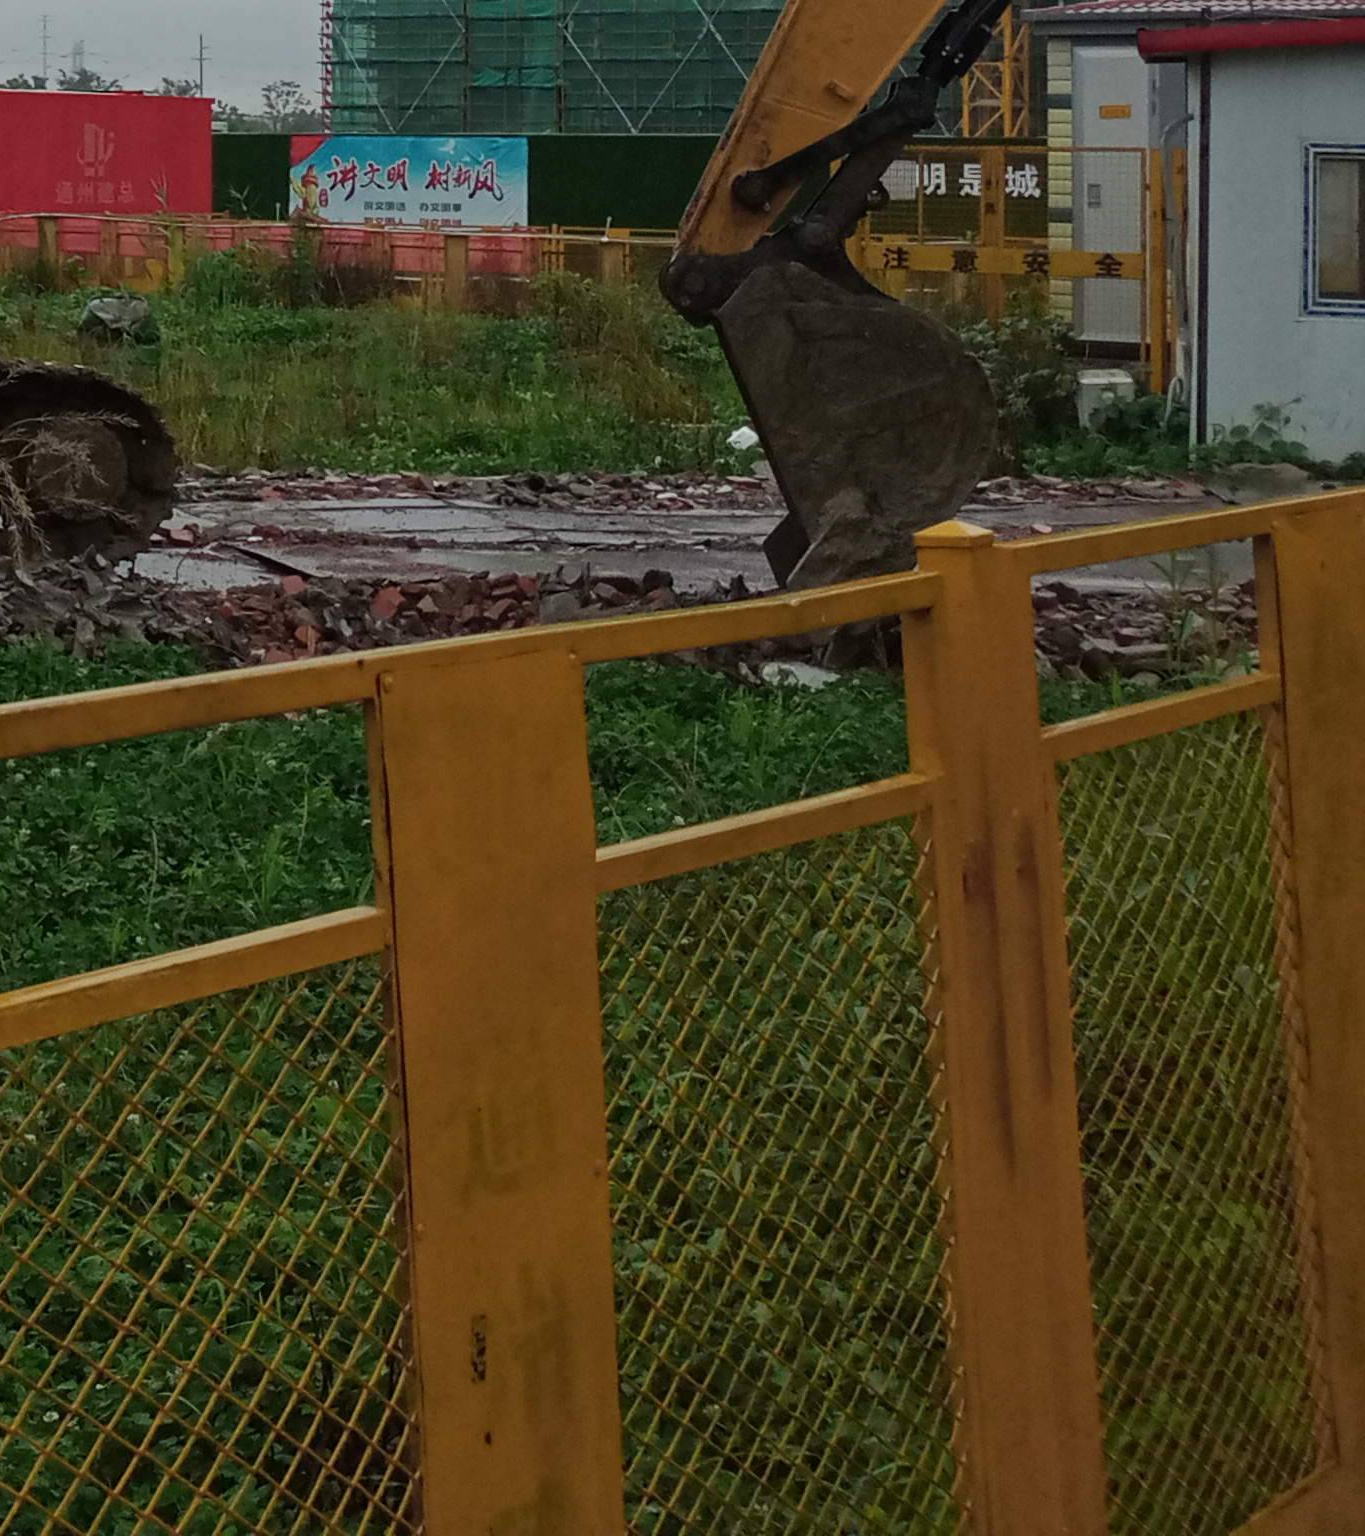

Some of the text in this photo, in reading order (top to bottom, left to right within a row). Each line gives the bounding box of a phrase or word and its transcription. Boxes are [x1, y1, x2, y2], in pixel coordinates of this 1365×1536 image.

[327, 156, 409, 201] 讲文明
[425, 160, 504, 202] 树新风
[882, 246, 1124, 278] 注意安全
